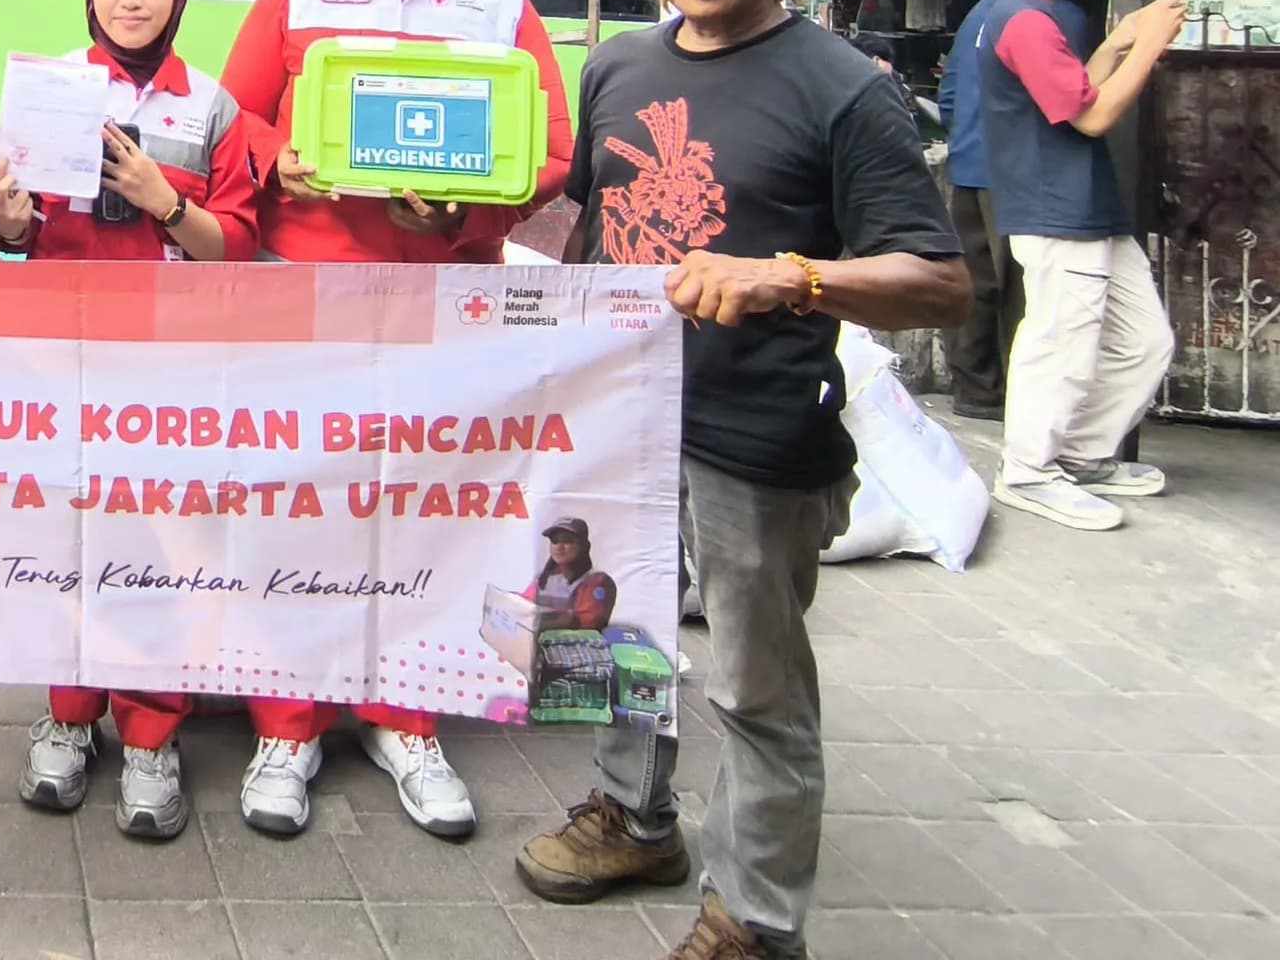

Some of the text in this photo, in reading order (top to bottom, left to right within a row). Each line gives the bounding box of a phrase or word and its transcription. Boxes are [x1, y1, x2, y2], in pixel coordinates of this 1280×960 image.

[355, 146, 485, 170] HYGIENE KIT
[505, 287, 543, 301] Palang
[610, 288, 641, 300] KOTA
[504, 301, 540, 312] Merah
[609, 303, 662, 315] JAKARTA
[502, 314, 558, 327] Indonesia
[610, 319, 649, 330] UTARA
[80, 404, 300, 451] KORBAN
[322, 412, 575, 455] BENCANA
[70, 475, 324, 521] JAKARTA
[347, 480, 530, 521] UTARA
[1, 556, 83, 592] Terus
[96, 561, 250, 593] Kobarkan
[263, 568, 433, 600] Kebaikan!!
